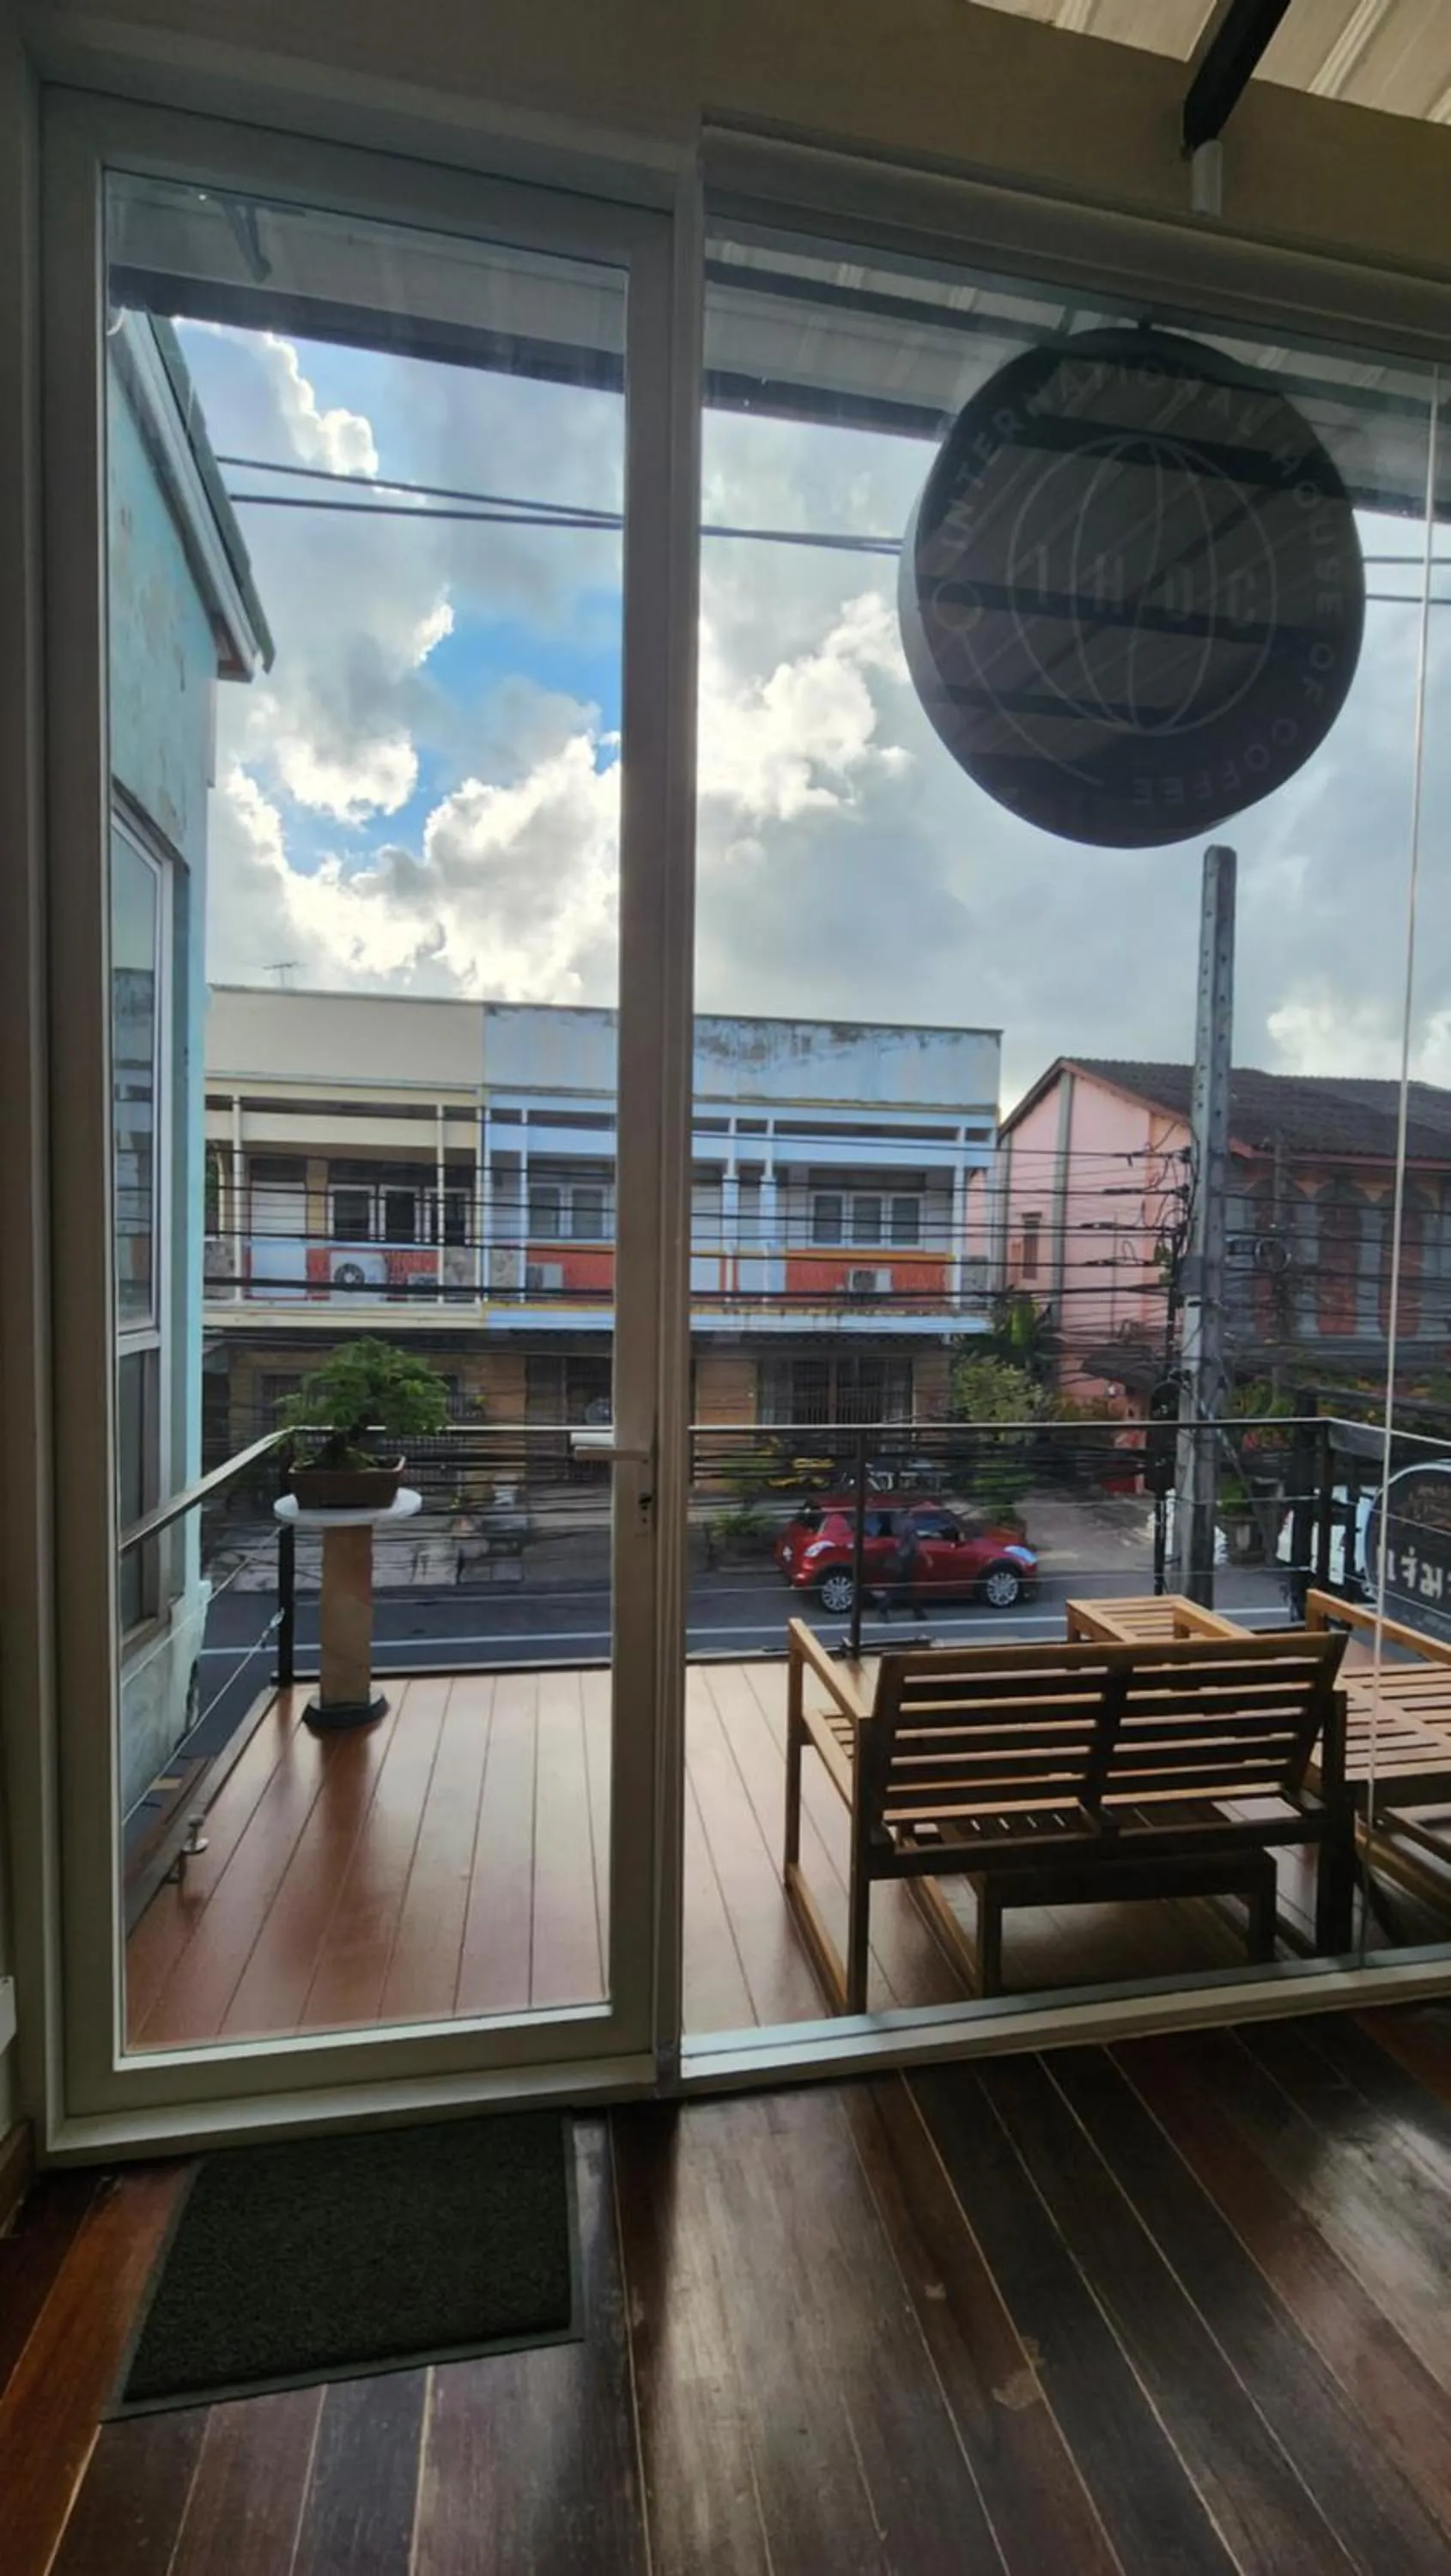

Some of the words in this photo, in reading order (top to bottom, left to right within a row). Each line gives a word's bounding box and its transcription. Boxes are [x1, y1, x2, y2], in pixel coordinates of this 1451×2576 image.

[1270, 443, 1345, 616] HOUSE
[1038, 543, 1257, 628] IHOC
[1302, 642, 1335, 706] OF
[1133, 718, 1298, 806] COFFEE
[1376, 1546, 1451, 1600] แจ่ม
